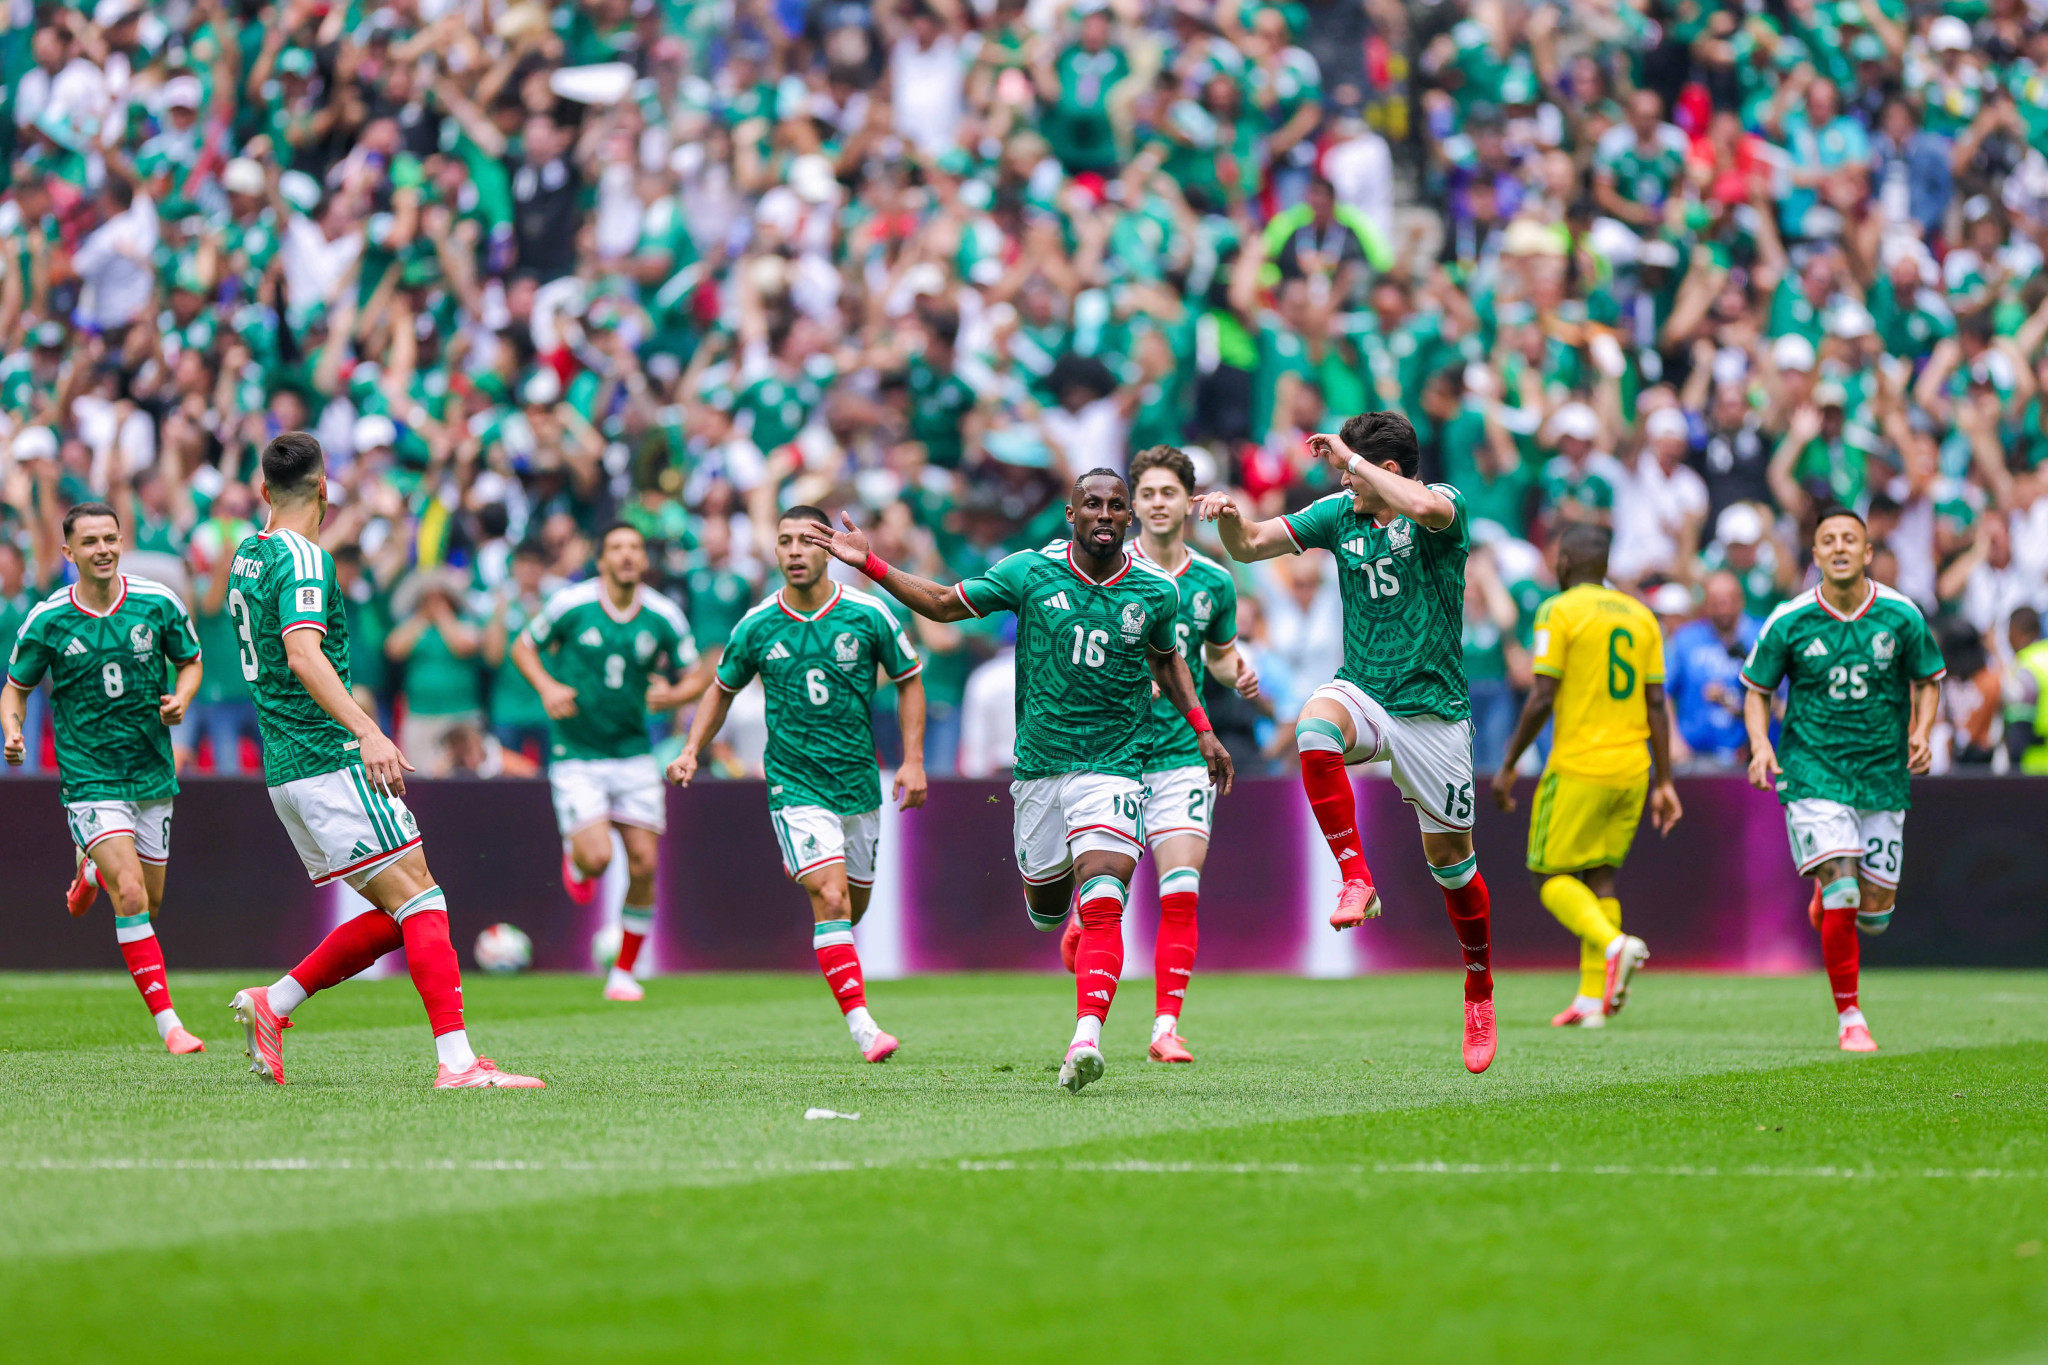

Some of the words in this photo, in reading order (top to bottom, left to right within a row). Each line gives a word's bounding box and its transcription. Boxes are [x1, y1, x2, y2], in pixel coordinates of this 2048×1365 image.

[1361, 557, 1400, 599] 15
[228, 588, 259, 682] 3
[1072, 625, 1109, 667] 16
[1175, 622, 1190, 659] 6
[102, 662, 124, 699] 8
[1608, 627, 1635, 700] 6
[1828, 663, 1869, 701] 25
[806, 668, 829, 706] 6
[1113, 793, 1138, 821] 16
[1445, 782, 1471, 819] 15
[1865, 837, 1902, 873] 25
